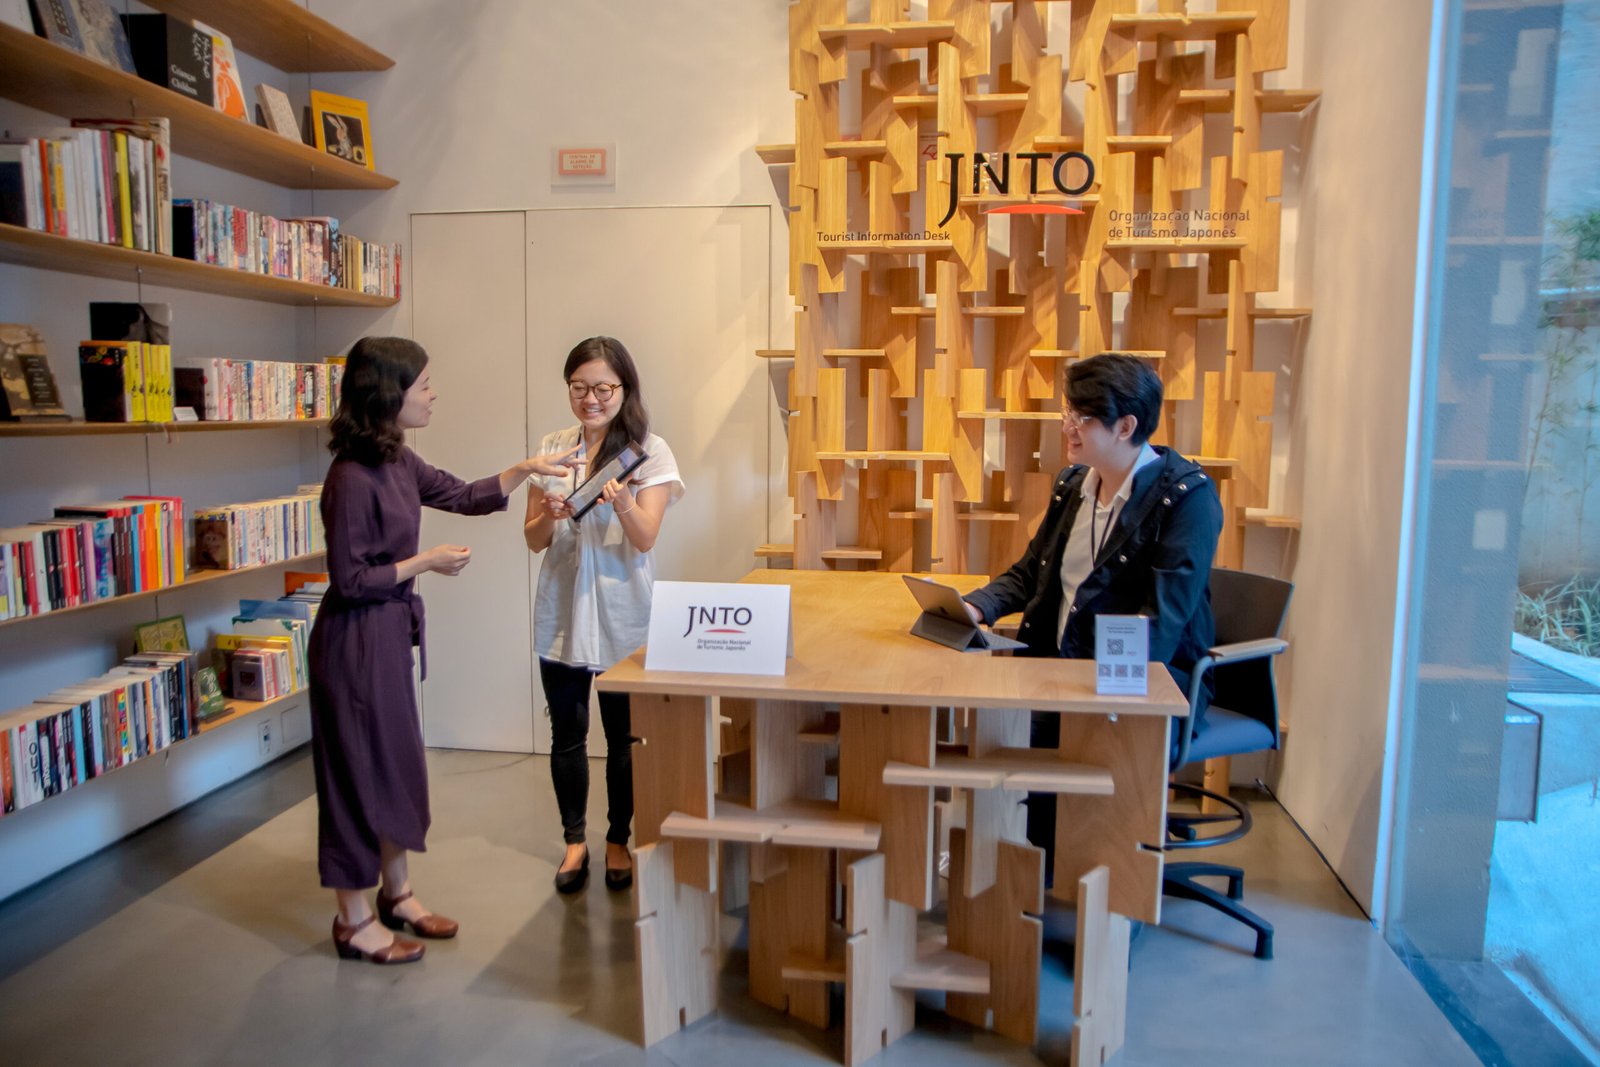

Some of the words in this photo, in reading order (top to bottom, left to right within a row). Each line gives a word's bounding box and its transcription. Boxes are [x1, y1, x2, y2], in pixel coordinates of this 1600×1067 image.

[938, 152, 1095, 228] JNTO
[1109, 209, 1190, 224] Organização
[1194, 209, 1250, 222] Nacional
[817, 231, 855, 242] Tourist
[857, 231, 921, 242] Information
[923, 230, 950, 241] Desk
[1108, 227, 1123, 238] de
[1126, 227, 1179, 238] Turismo
[1182, 227, 1237, 241] Japonês
[683, 606, 752, 638] JNTO
[29, 742, 39, 784] OUT
